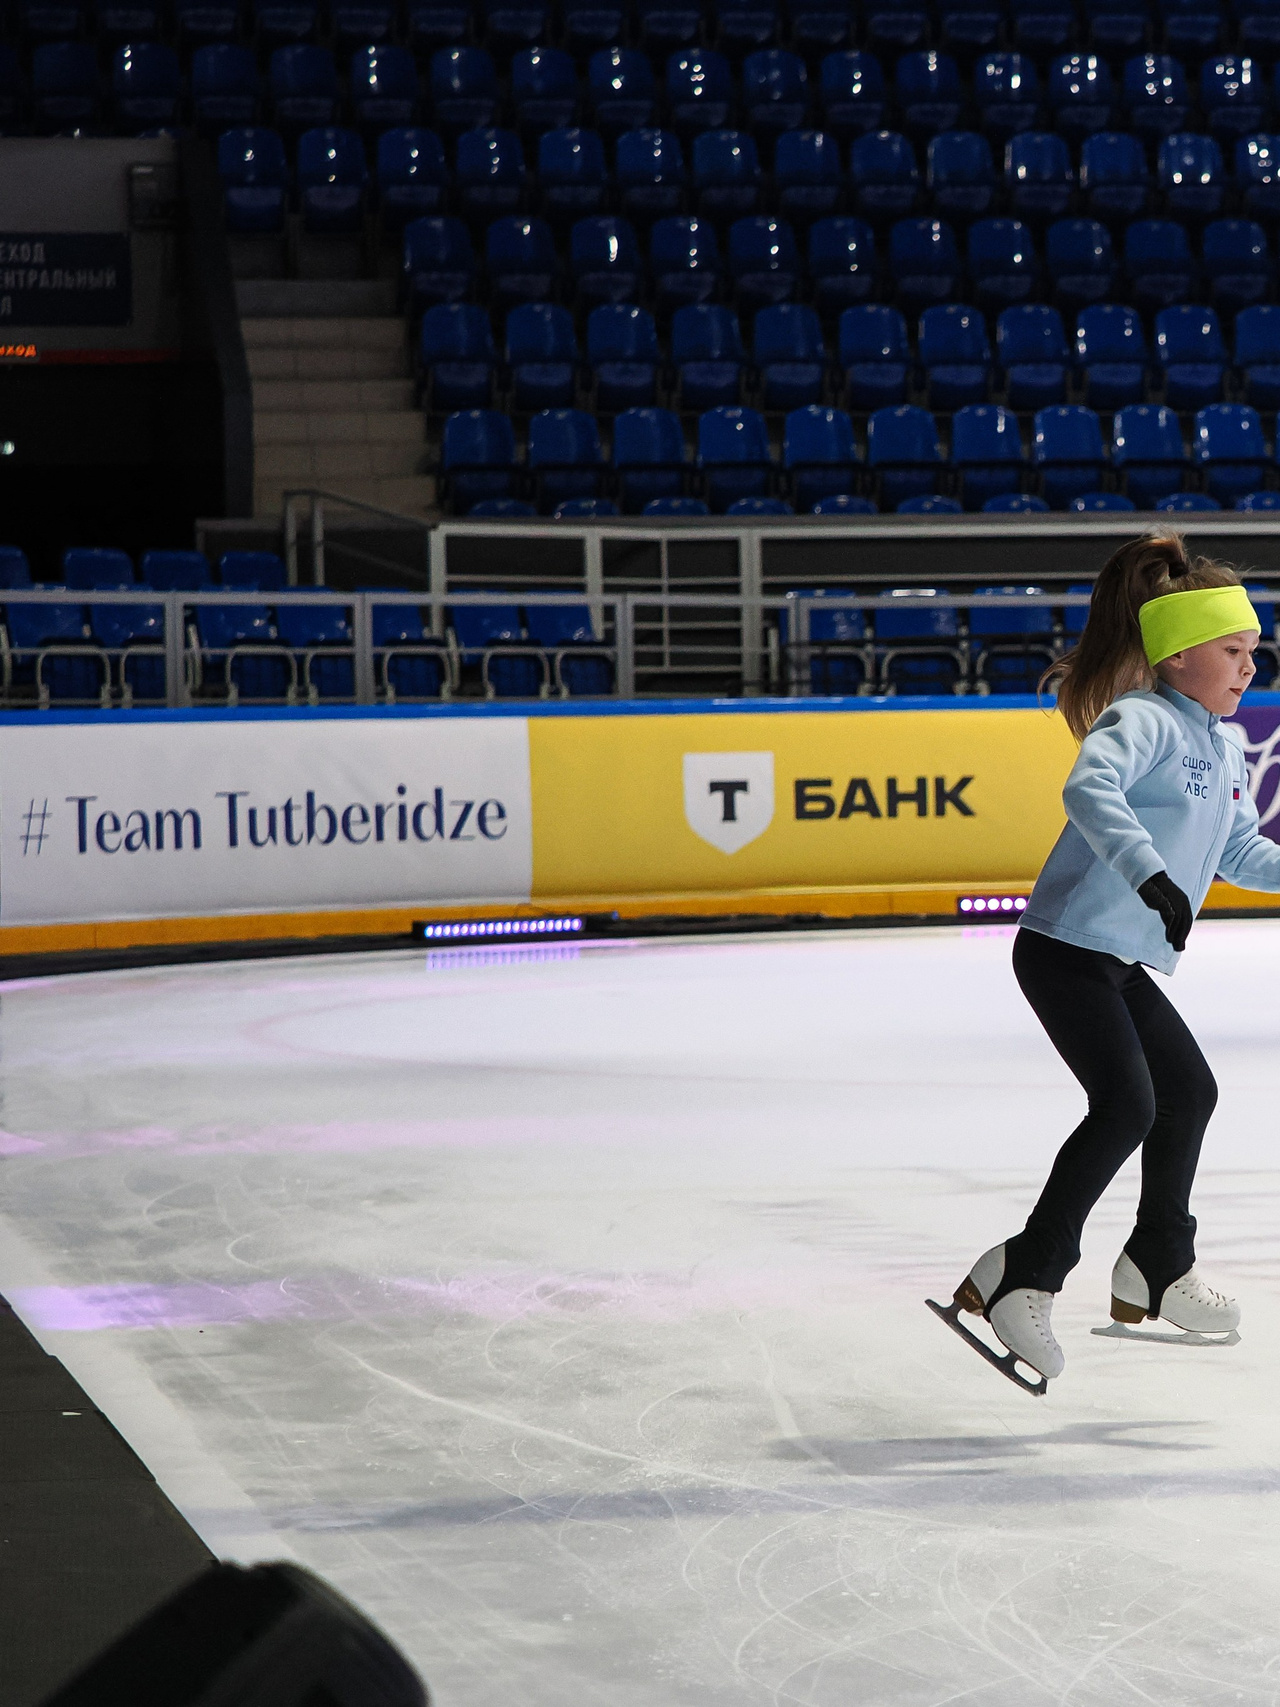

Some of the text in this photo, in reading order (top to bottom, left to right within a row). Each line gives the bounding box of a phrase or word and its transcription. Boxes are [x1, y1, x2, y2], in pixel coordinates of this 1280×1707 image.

[1182, 755, 1212, 772] СШОР
[65, 794, 203, 855] Team
[214, 782, 509, 849] Tutberidze
[794, 775, 976, 821] БАНК
